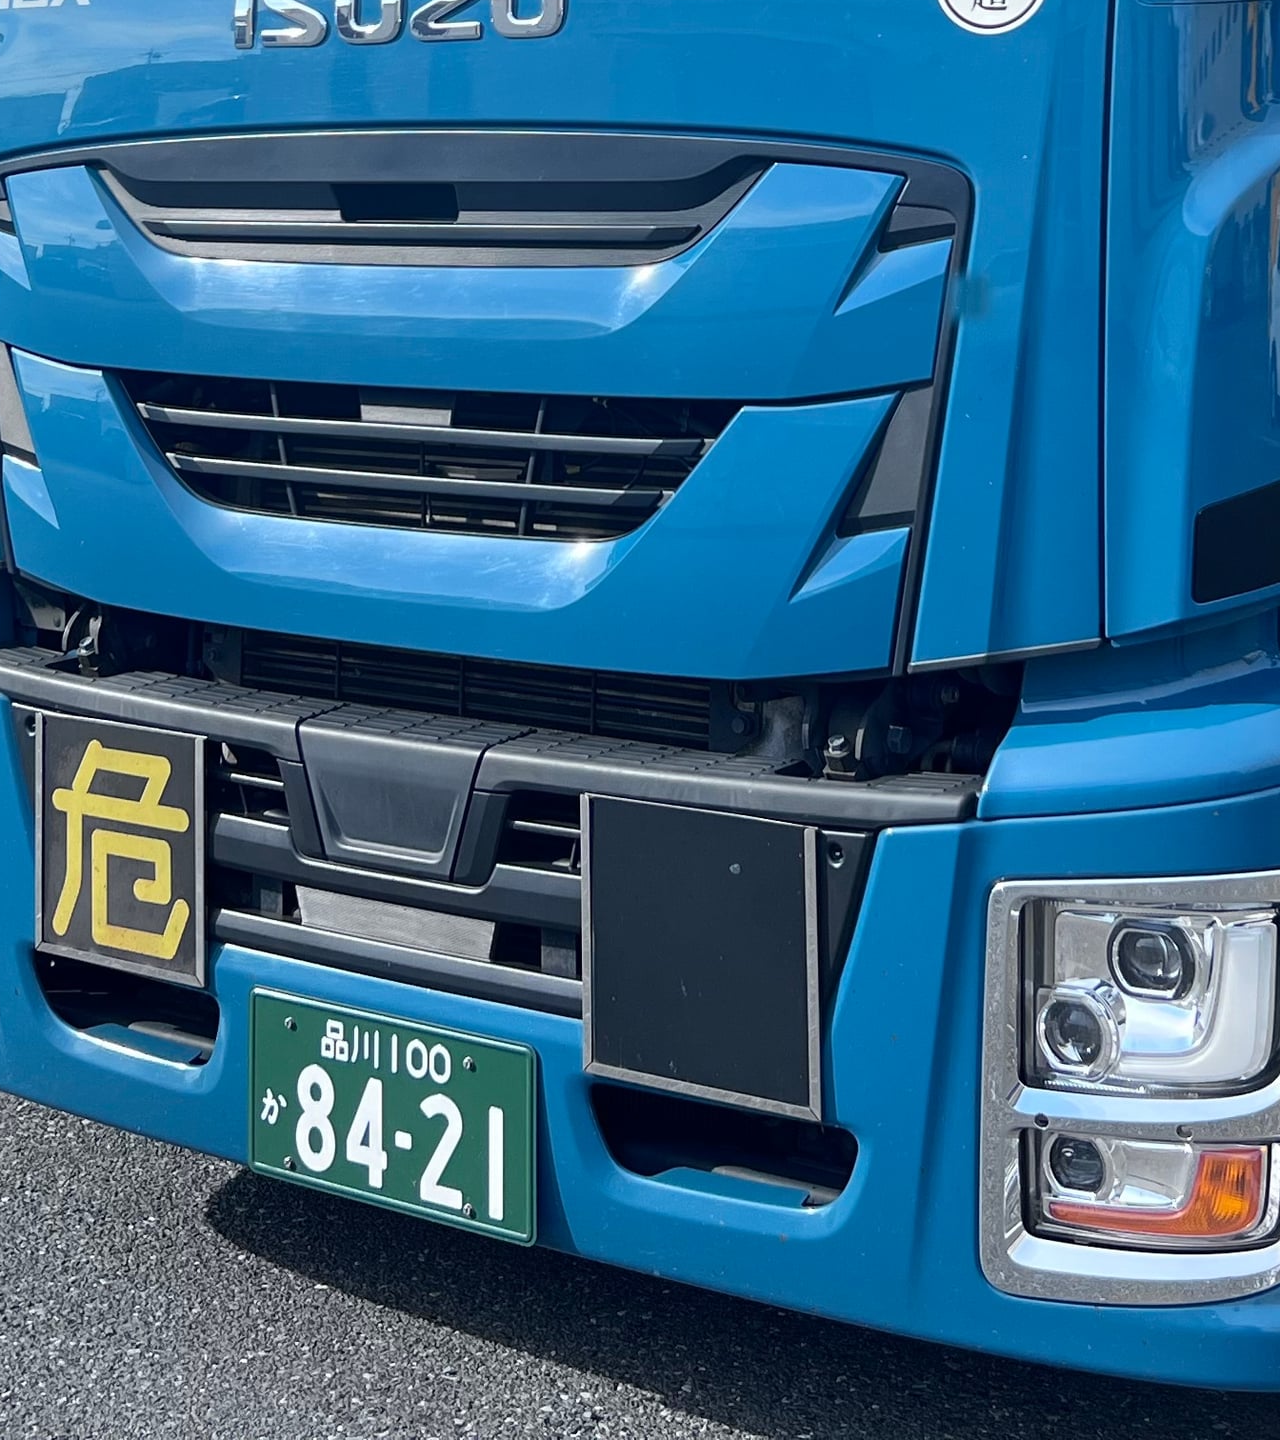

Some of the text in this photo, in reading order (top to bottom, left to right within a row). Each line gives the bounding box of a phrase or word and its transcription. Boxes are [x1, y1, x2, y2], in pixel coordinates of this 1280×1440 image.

[51, 739, 190, 960] 危
[261, 1063, 504, 1222] か 84-21
